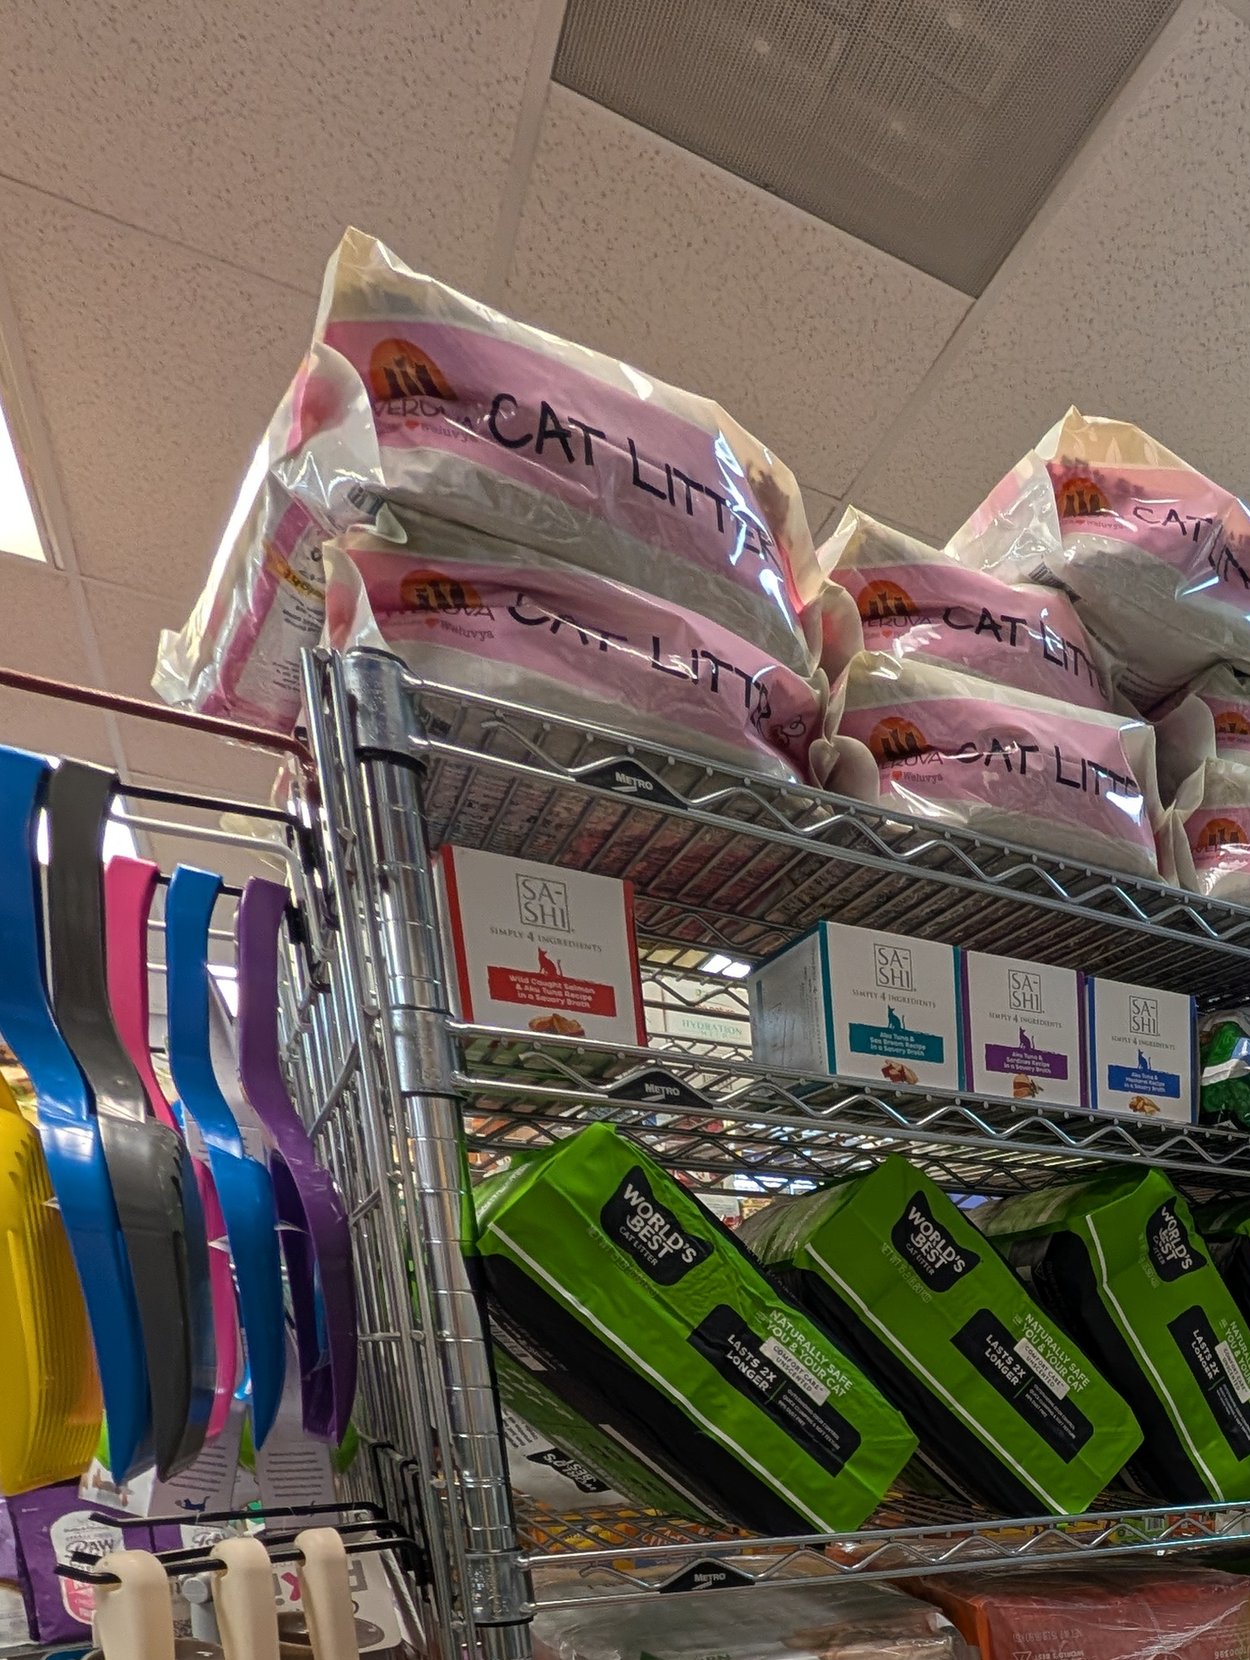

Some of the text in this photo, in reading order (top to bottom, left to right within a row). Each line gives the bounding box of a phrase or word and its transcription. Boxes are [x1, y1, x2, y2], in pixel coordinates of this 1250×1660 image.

[488, 393, 606, 466] CAT
[1133, 507, 1213, 543] CAT
[943, 606, 1027, 647] CAT
[615, 771, 653, 791] METRO
[524, 901, 566, 928] SHI
[489, 926, 602, 953] SIMPLY INGREDIENTS
[878, 966, 910, 989] SHI
[852, 989, 936, 1009] SIMPLY INGREDIENTS
[1012, 990, 1039, 1011] SHI
[1020, 1016, 1062, 1029] INGREDIENTS
[645, 1083, 680, 1097] METRO
[623, 1183, 697, 1264] WORLD'S
[626, 1215, 674, 1259] BEST
[908, 1206, 966, 1273] WORLD'S
[632, 1240, 659, 1267] LITTER
[910, 1232, 949, 1269] BEST
[765, 1321, 848, 1398] YOU YOUR CAT
[769, 1310, 853, 1391] NATURALLY SAFE
[773, 1345, 803, 1377] COMFORT
[1024, 1313, 1091, 1388] NATURALLY SAFE
[760, 1364, 776, 1383] 2X
[775, 1357, 812, 1392] UNSCENTED
[694, 1572, 726, 1585] METRO
